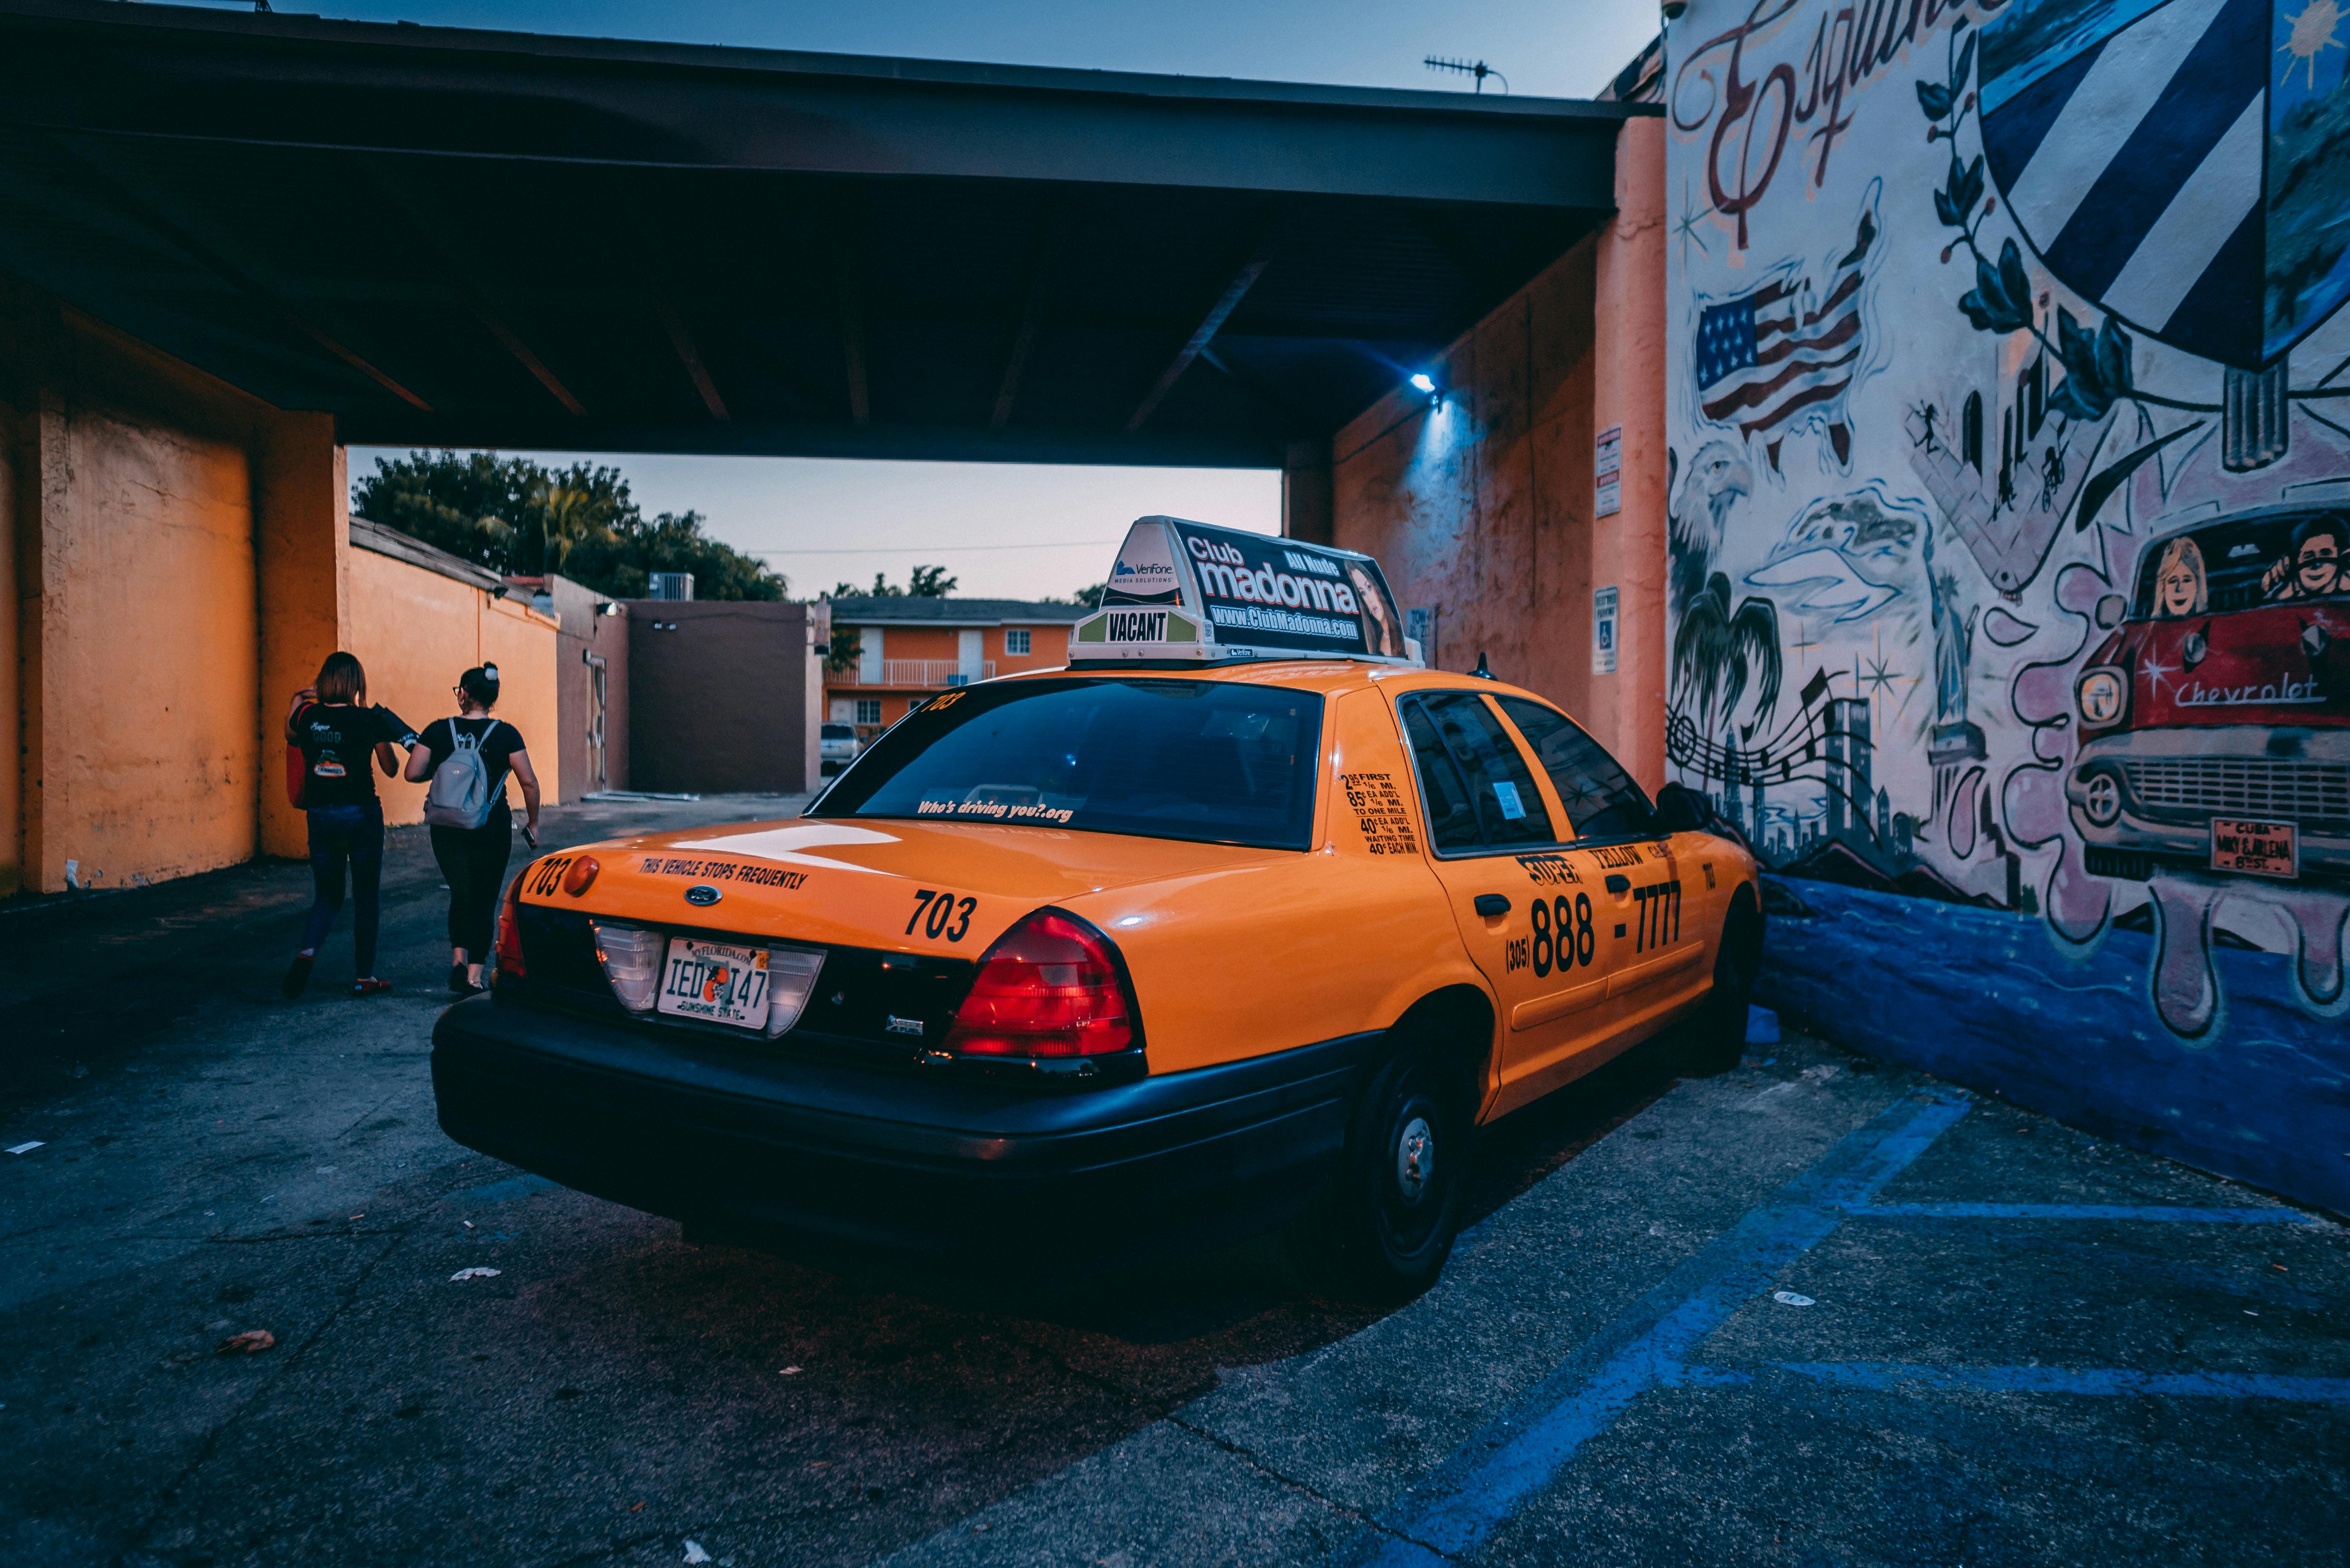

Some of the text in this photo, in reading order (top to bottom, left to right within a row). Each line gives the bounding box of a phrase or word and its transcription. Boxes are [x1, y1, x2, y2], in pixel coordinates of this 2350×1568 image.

[1187, 536, 1245, 566] Club
[1284, 550, 1340, 577] All Nude
[1136, 564, 1172, 574] VeriFone
[1196, 560, 1360, 615] madonna
[1110, 613, 1167, 642] VACANT
[1210, 605, 1359, 640] www.ClubMadonna.com
[920, 691, 967, 713] 703
[2175, 672, 2327, 707] Chevrolet
[918, 800, 1073, 823] Who's driving you?.org
[1370, 799, 1384, 807] 1/6
[1381, 826, 1394, 834] 1/6
[2235, 822, 2270, 835] CUBA
[1387, 843, 1405, 854] EACH
[527, 858, 572, 896] 703
[639, 858, 809, 890] THIS VEHICLE STOPS FREQUENTLY
[1515, 855, 1583, 886] SUPER
[1588, 846, 1645, 869] YELLOW
[690, 888, 712, 901] Ford
[905, 889, 977, 942] 703
[1506, 934, 1530, 975] (305)
[1531, 892, 1594, 978] 888
[1633, 880, 1680, 954] 7777
[667, 959, 704, 999] IED
[681, 1001, 741, 1020] SUNSHINE STATE
